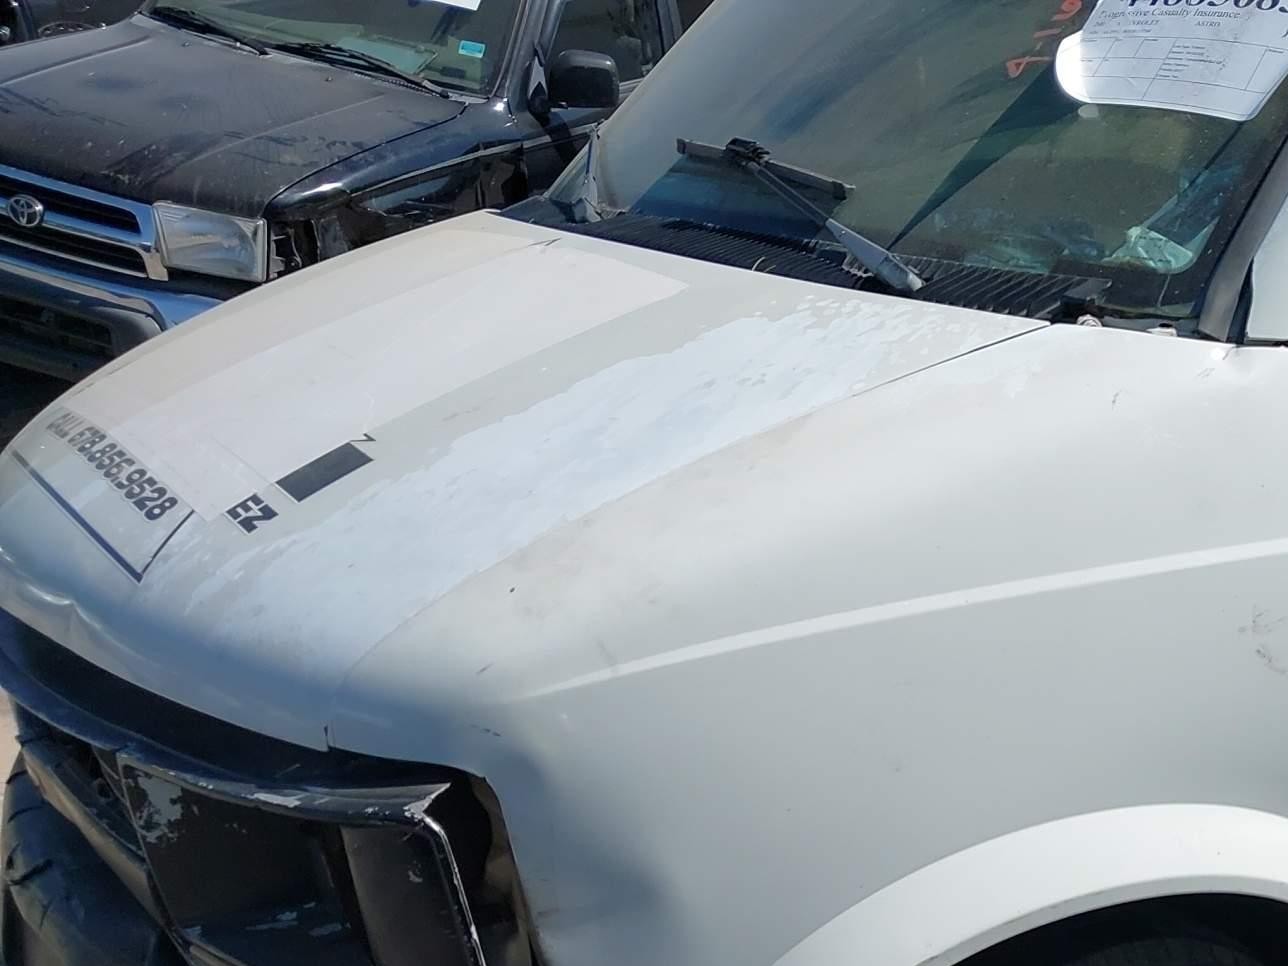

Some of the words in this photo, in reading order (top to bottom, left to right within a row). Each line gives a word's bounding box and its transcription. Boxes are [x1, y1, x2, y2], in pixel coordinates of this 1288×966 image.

[1151, 7, 1191, 19] Casualty
[1193, 8, 1241, 19] Insurance
[67, 426, 179, 521] 678.856.9528
[223, 492, 279, 534] EZ
